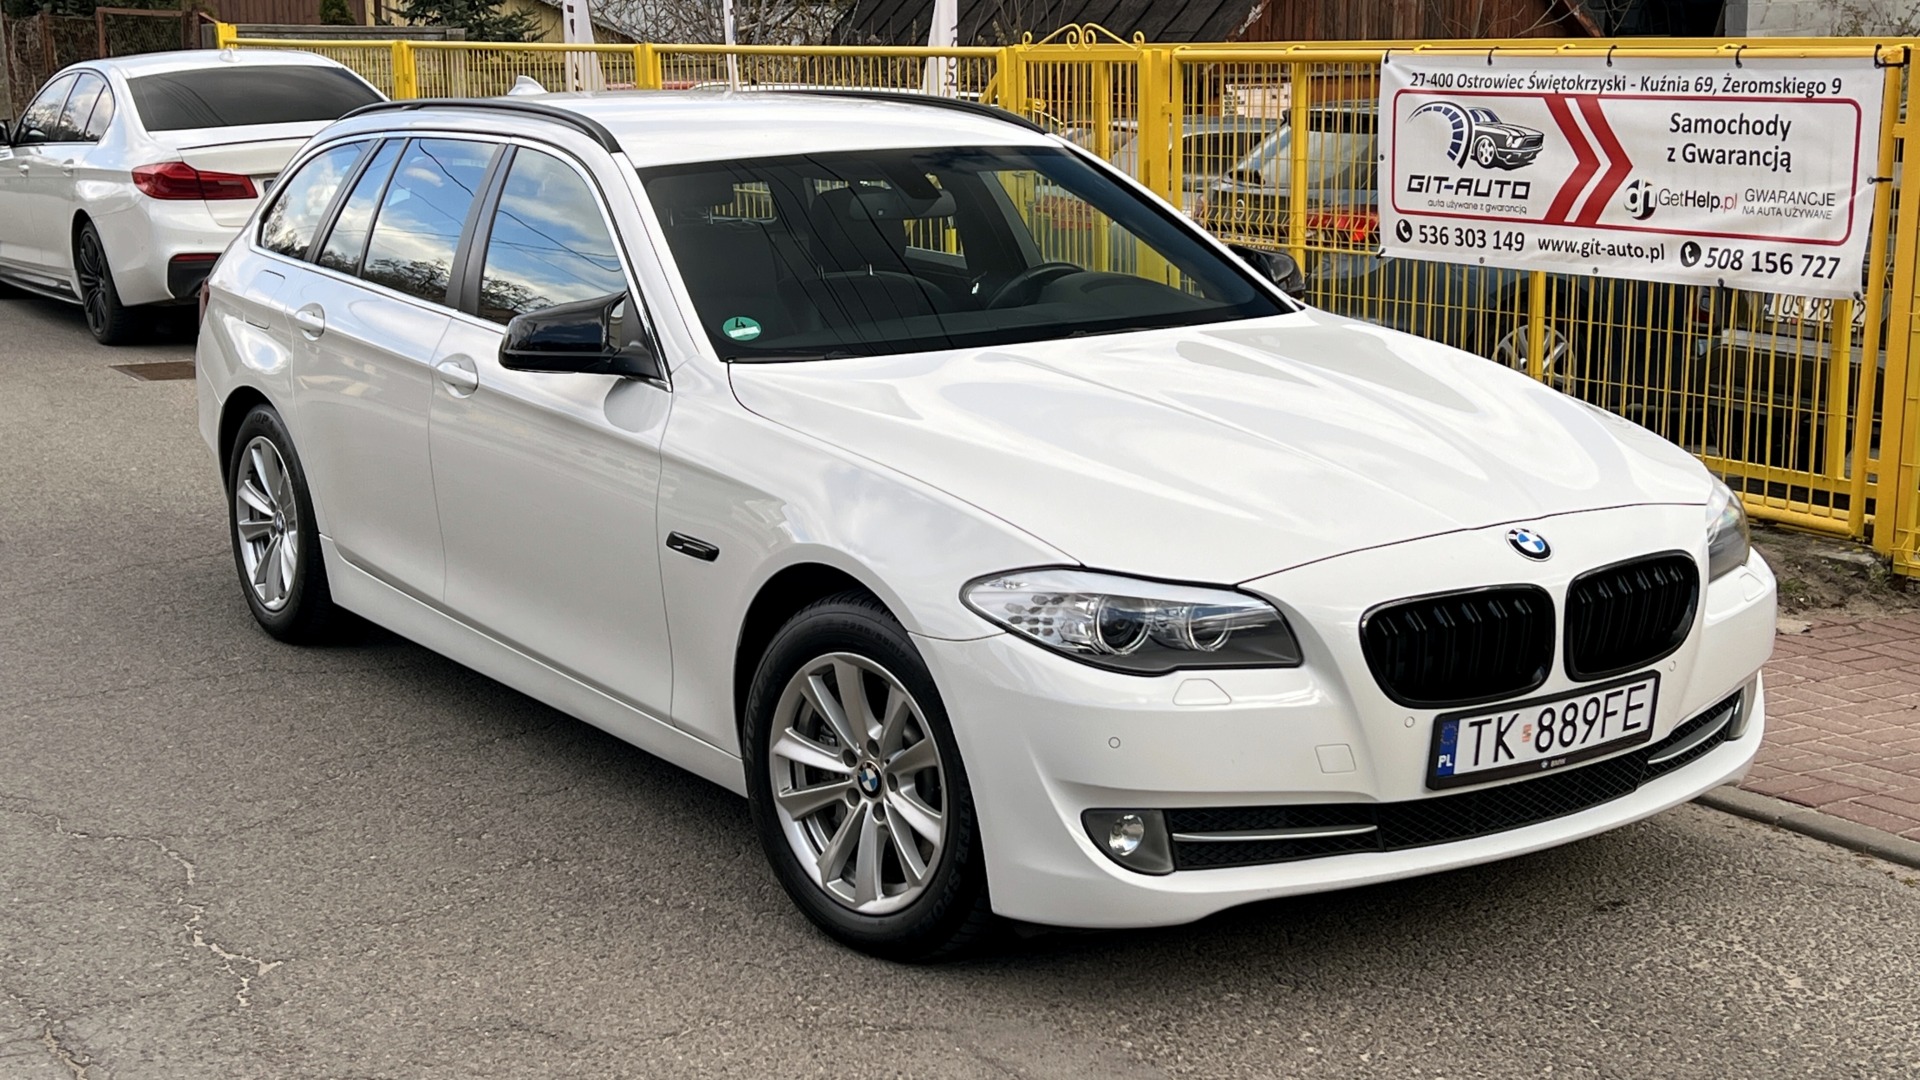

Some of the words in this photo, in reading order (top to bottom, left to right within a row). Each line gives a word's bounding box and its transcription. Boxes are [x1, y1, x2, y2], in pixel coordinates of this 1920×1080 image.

[1410, 72, 1453, 88] 27-400
[1456, 73, 1524, 90] Ostrowiec
[1527, 71, 1626, 94] Świętokrzyski
[1640, 76, 1689, 93] Kuźnia
[1694, 77, 1717, 95] 69,
[1722, 73, 1826, 98] Żeromskiego
[1831, 78, 1842, 94] 9
[1669, 112, 1792, 141] Samochody
[1667, 146, 1676, 163] z
[1682, 143, 1792, 172] Gwarancją
[1407, 174, 1531, 200] GIT-AUTO
[1744, 188, 1836, 207] GWARANCJE
[1428, 199, 1445, 208] auta
[1446, 199, 1478, 211] używane
[1480, 202, 1485, 211] z
[1485, 203, 1527, 215] gwarancją
[1659, 188, 1738, 213] GetHelp.pl
[1742, 206, 1755, 215] NA
[1757, 206, 1782, 217] AUTA
[1784, 207, 1833, 220] UŻYWANE
[1418, 224, 1449, 245] 536
[1454, 227, 1487, 249] 303
[1493, 230, 1525, 252] 149
[1537, 238, 1665, 264] www.git-auto.pl
[1704, 247, 1744, 271] 508
[1751, 251, 1793, 275] 156
[1801, 254, 1841, 279] 727
[1468, 712, 1520, 766] TK
[1535, 684, 1647, 753] 889FE
[1437, 754, 1453, 769] PL
